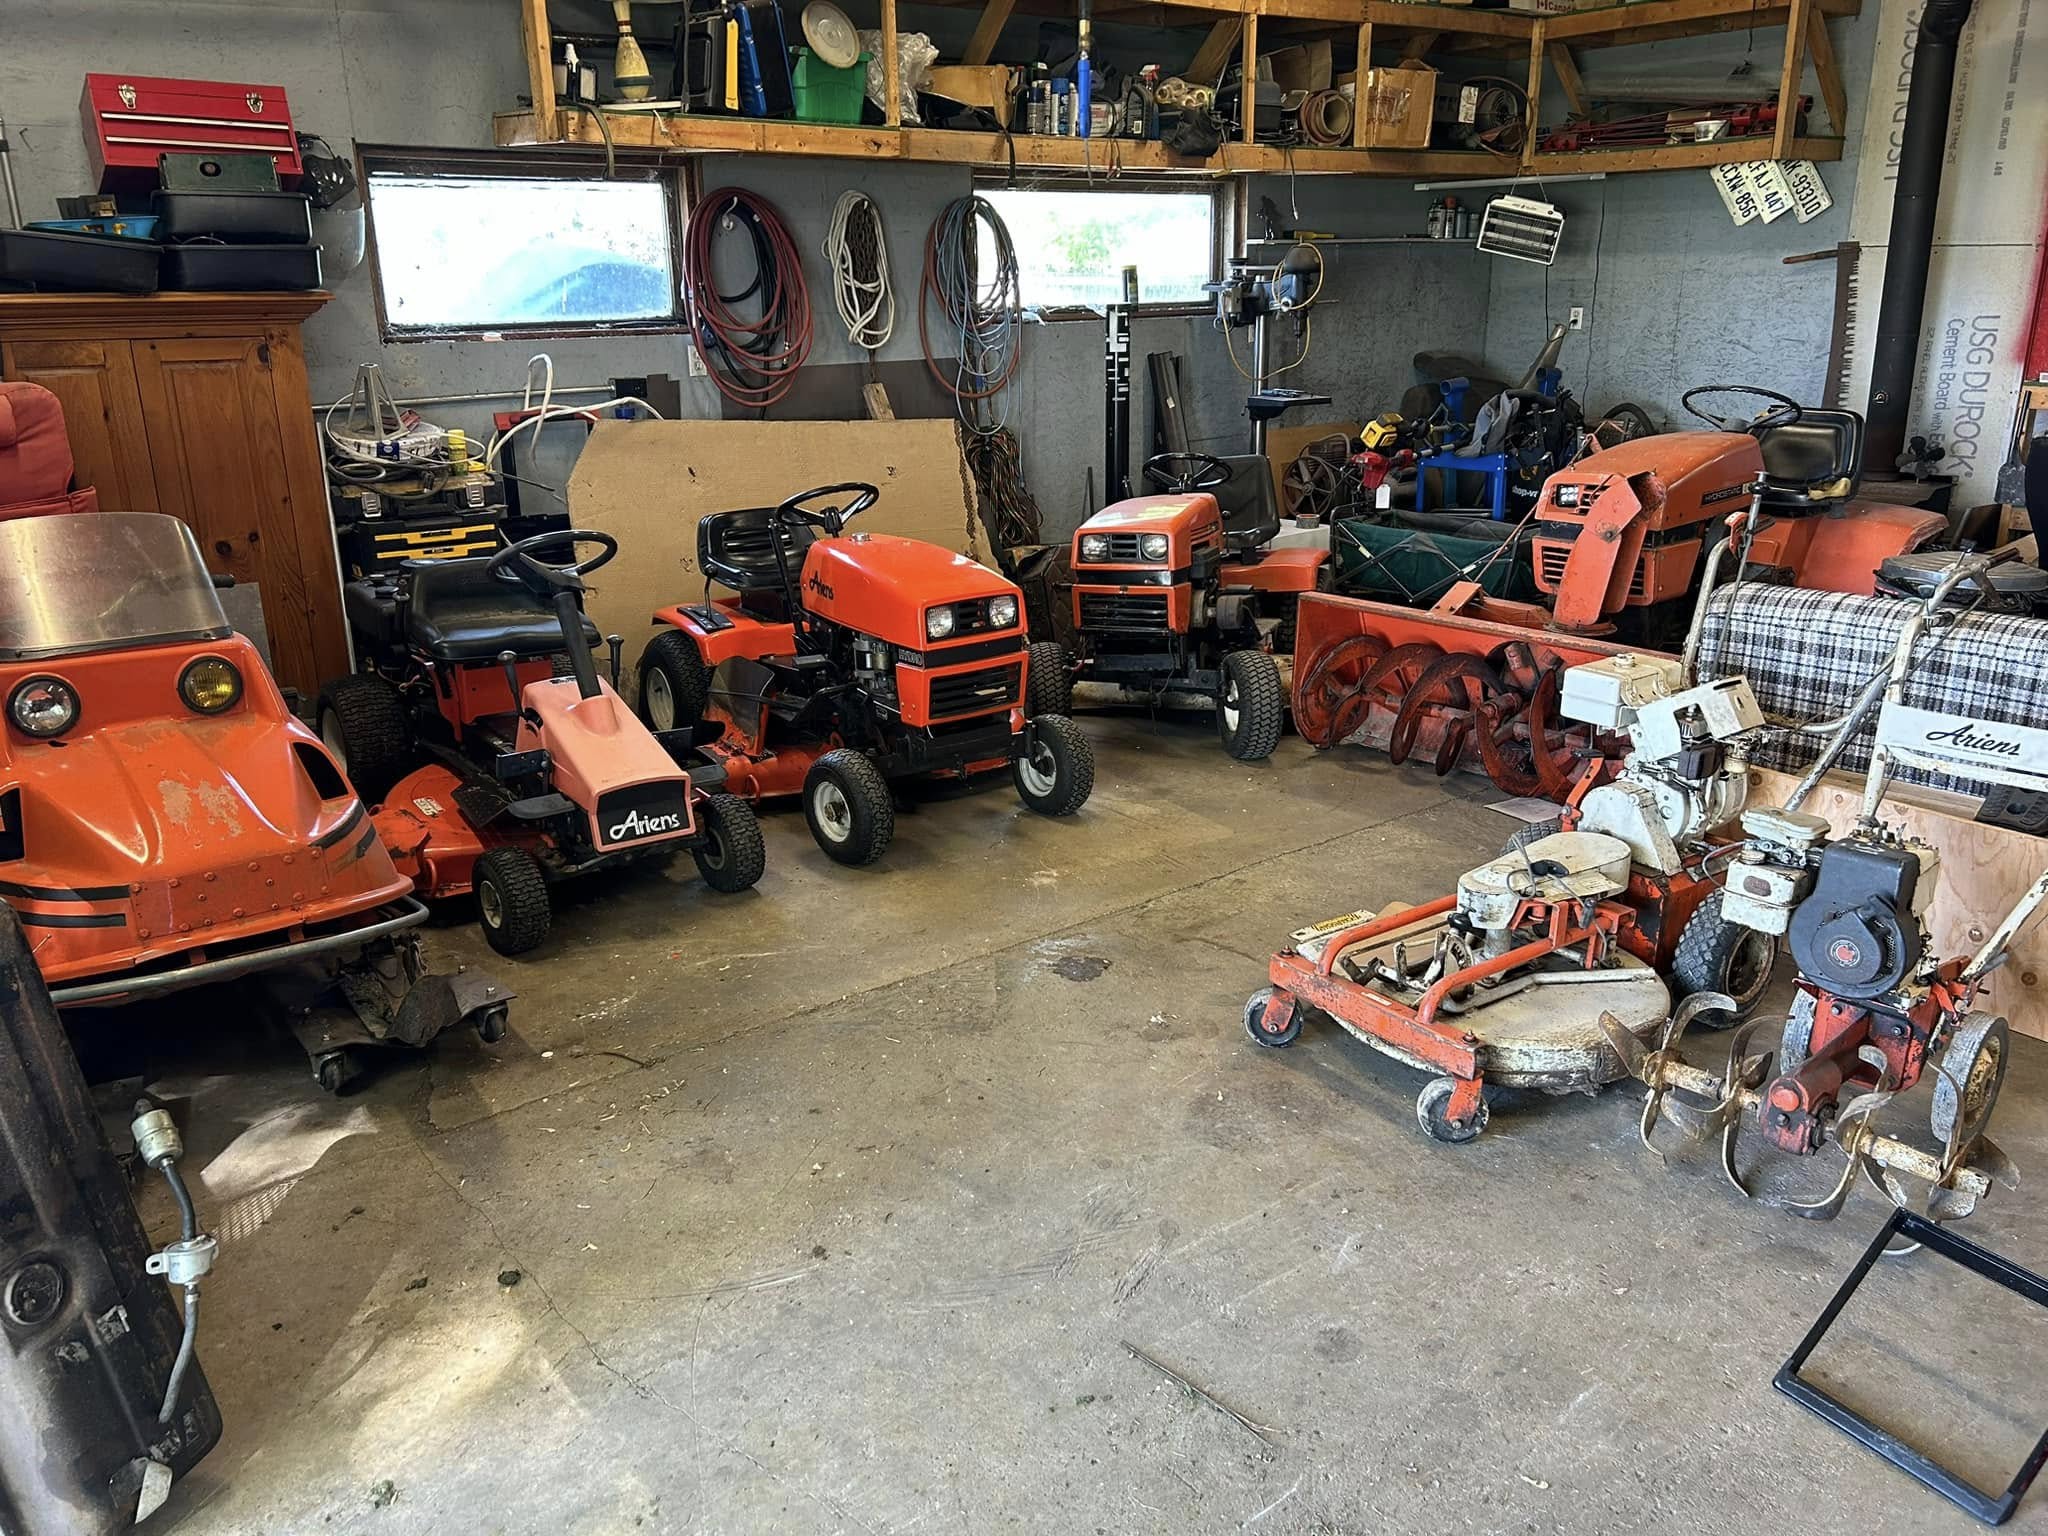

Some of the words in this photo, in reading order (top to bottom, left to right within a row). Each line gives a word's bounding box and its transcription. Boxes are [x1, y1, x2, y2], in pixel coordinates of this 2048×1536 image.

[1735, 192, 1758, 218] 856
[1764, 191, 1785, 214] 447
[1792, 174, 1821, 215] 93310
[1939, 318, 1965, 369] Cement
[1966, 315, 2000, 365] USG
[1933, 372, 1956, 410] Board
[1930, 412, 1944, 431] with
[809, 570, 834, 600] Ariens
[1925, 723, 2021, 756] Ariens
[609, 810, 681, 840] Ariens
